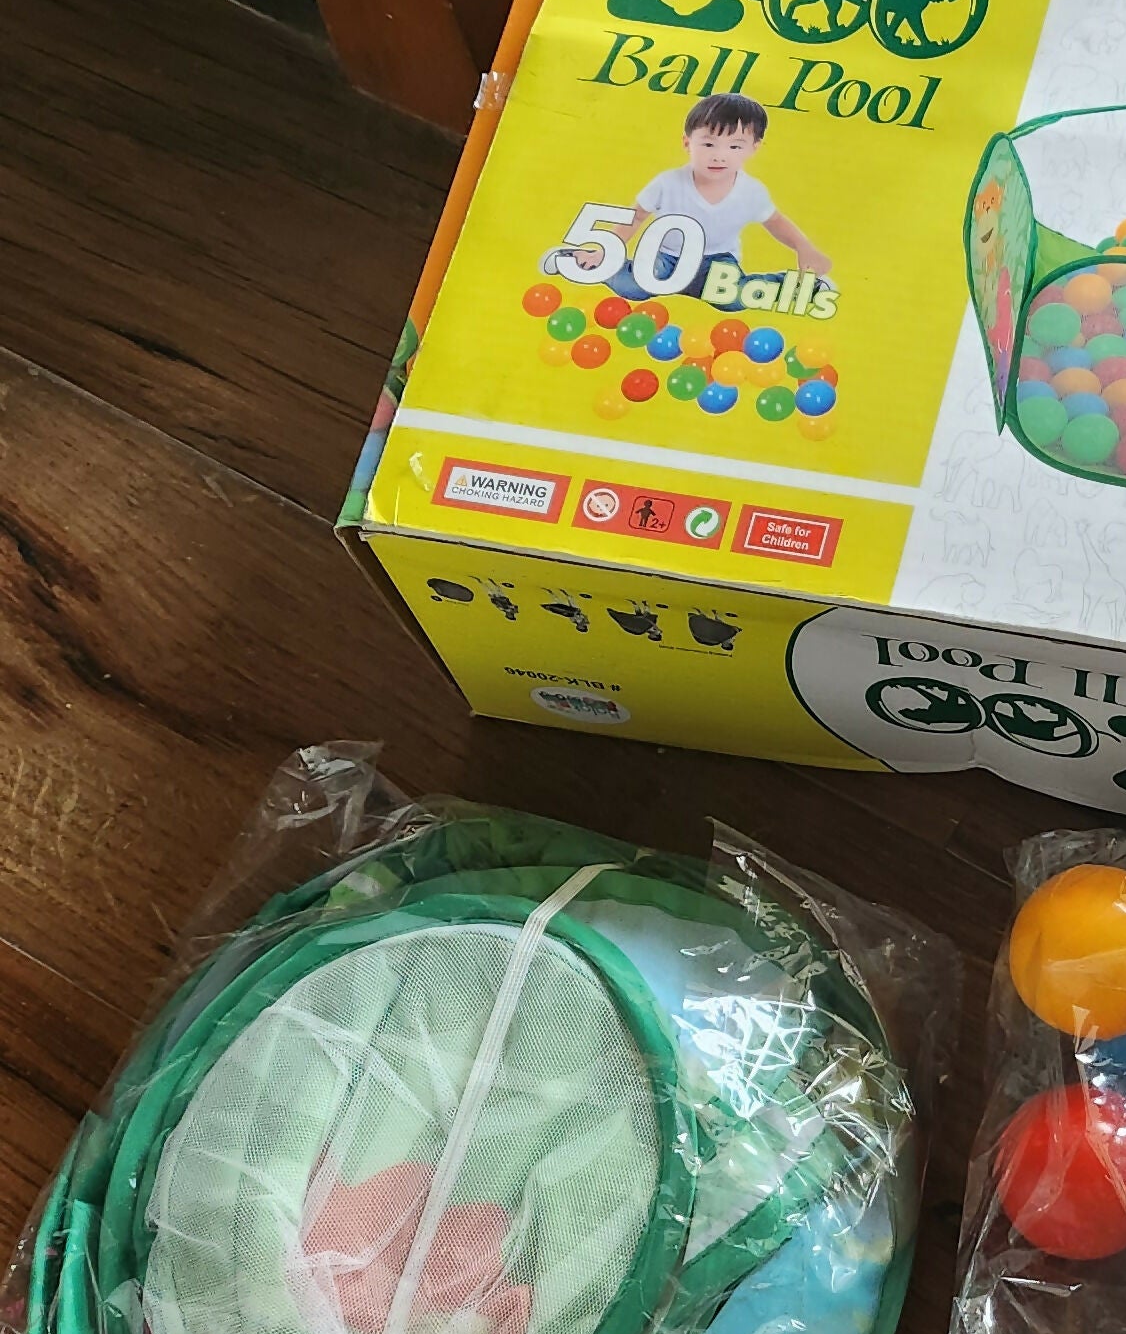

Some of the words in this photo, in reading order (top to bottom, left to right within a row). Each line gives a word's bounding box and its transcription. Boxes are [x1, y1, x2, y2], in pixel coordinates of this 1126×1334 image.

[577, 30, 760, 97] Ball
[763, 56, 943, 131] Pool
[553, 202, 706, 295] 50
[700, 260, 841, 319] Balls
[451, 486, 500, 500] CHOKING
[502, 495, 545, 508] HAZARD
[471, 475, 547, 498] WARNING
[651, 518, 666, 529] 2+
[767, 521, 792, 535] Safe
[794, 525, 812, 537] for
[761, 534, 809, 550] Children
[861, 634, 1044, 689] Pool
